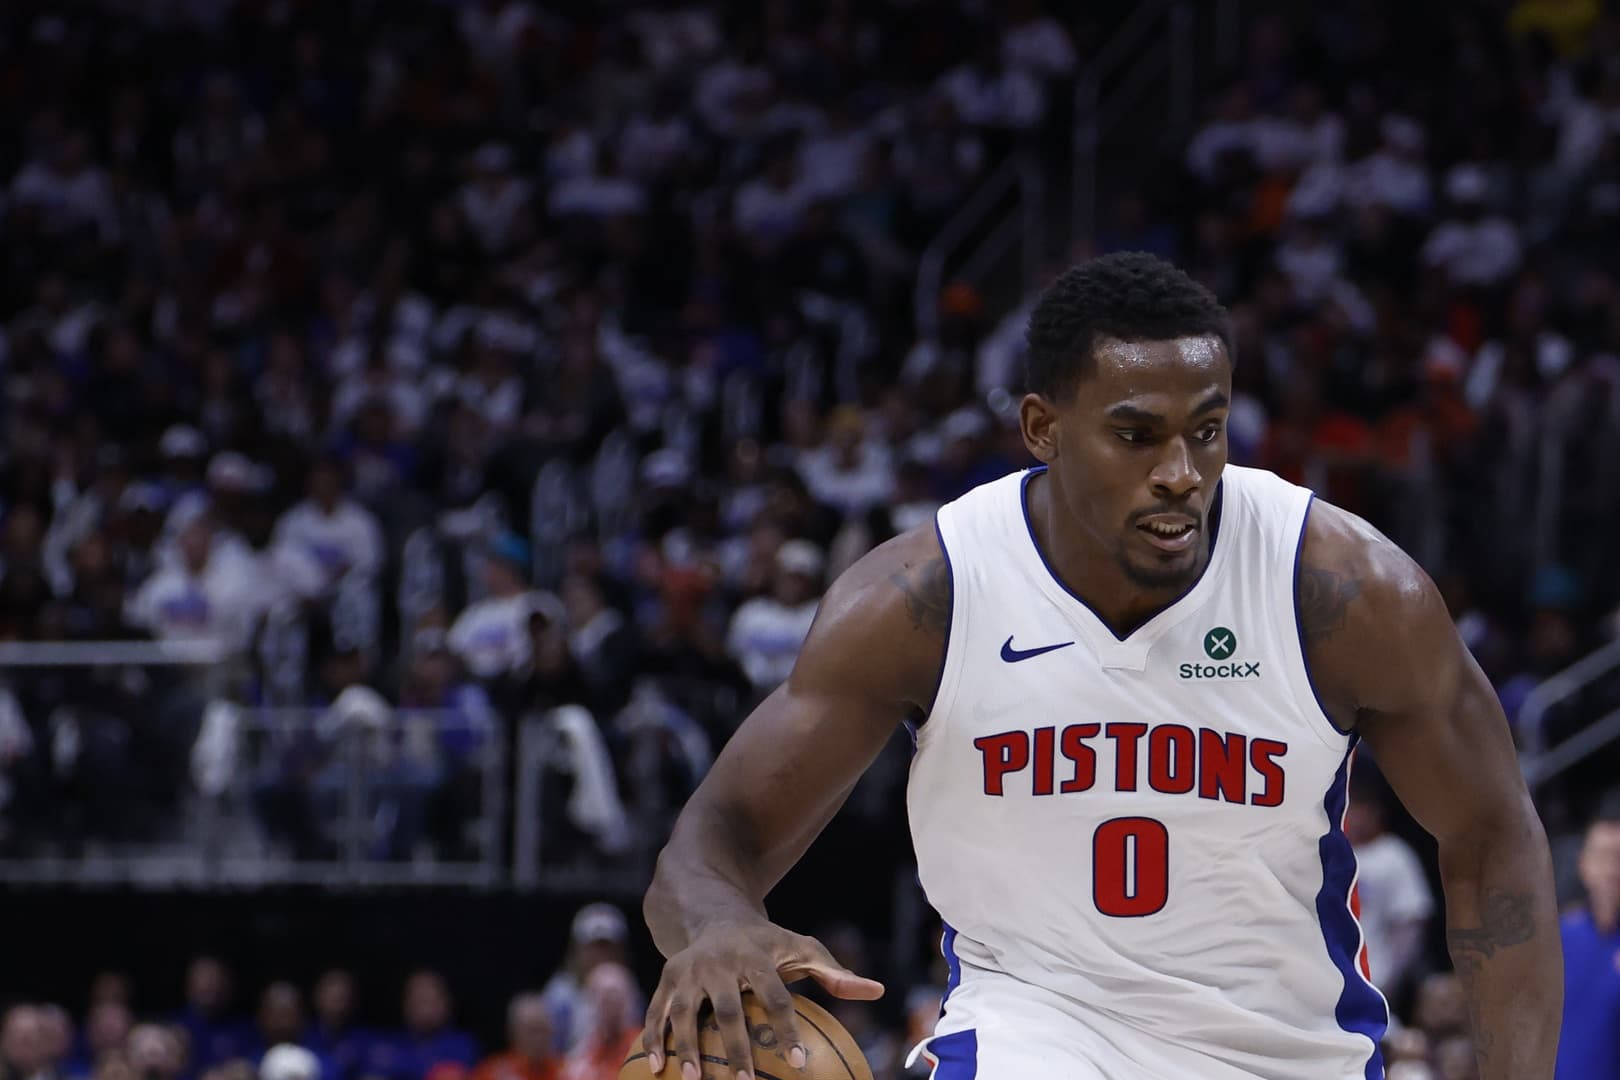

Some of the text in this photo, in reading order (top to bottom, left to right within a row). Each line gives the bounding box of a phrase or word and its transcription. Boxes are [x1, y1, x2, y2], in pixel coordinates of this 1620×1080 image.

[1179, 661, 1261, 679] StockX
[973, 721, 1288, 808] PISTONS
[1092, 816, 1169, 918] 0
